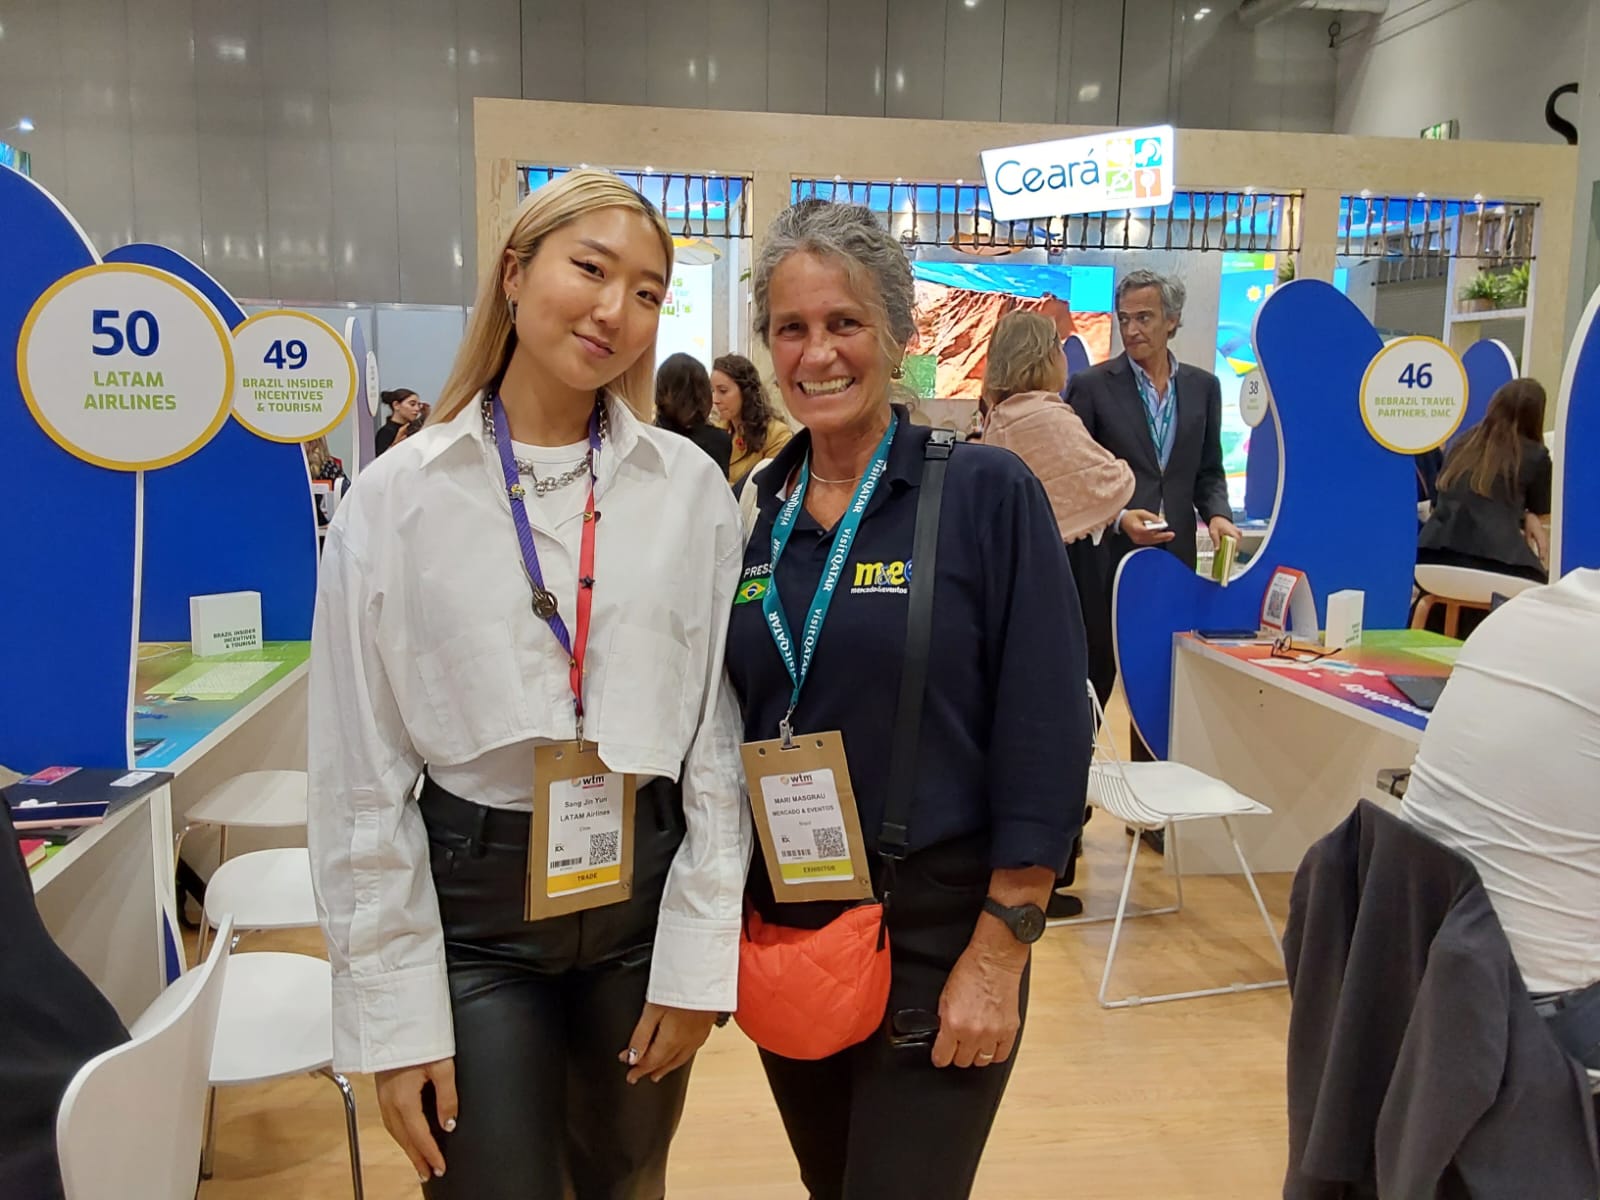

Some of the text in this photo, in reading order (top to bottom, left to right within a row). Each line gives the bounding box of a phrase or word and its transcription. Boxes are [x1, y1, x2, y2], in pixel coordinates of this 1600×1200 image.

[995, 148, 1100, 195] Ceará
[92, 309, 160, 357] 50
[263, 339, 308, 370] 49
[93, 370, 164, 387] LATAM
[1398, 362, 1432, 389] 46
[242, 378, 333, 388] BRAZIL INSIDER
[1249, 380, 1259, 395] 38
[83, 393, 177, 410] AIRLINES
[254, 390, 324, 401] INCENTIVES
[1374, 396, 1456, 406] BEBRAZIL TRAVEL
[256, 402, 322, 412] & TOURISM
[1431, 409, 1451, 417] DMC
[823, 528, 852, 592] visitQATAR
[582, 775, 605, 785] wtm
[790, 773, 813, 783] wtm
[792, 793, 826, 802] MASGRAU
[560, 809, 610, 822] LATAM Airlines
[772, 808, 800, 817] MERCADO
[807, 805, 834, 814] EVENTOS
[577, 872, 598, 881] TRADE
